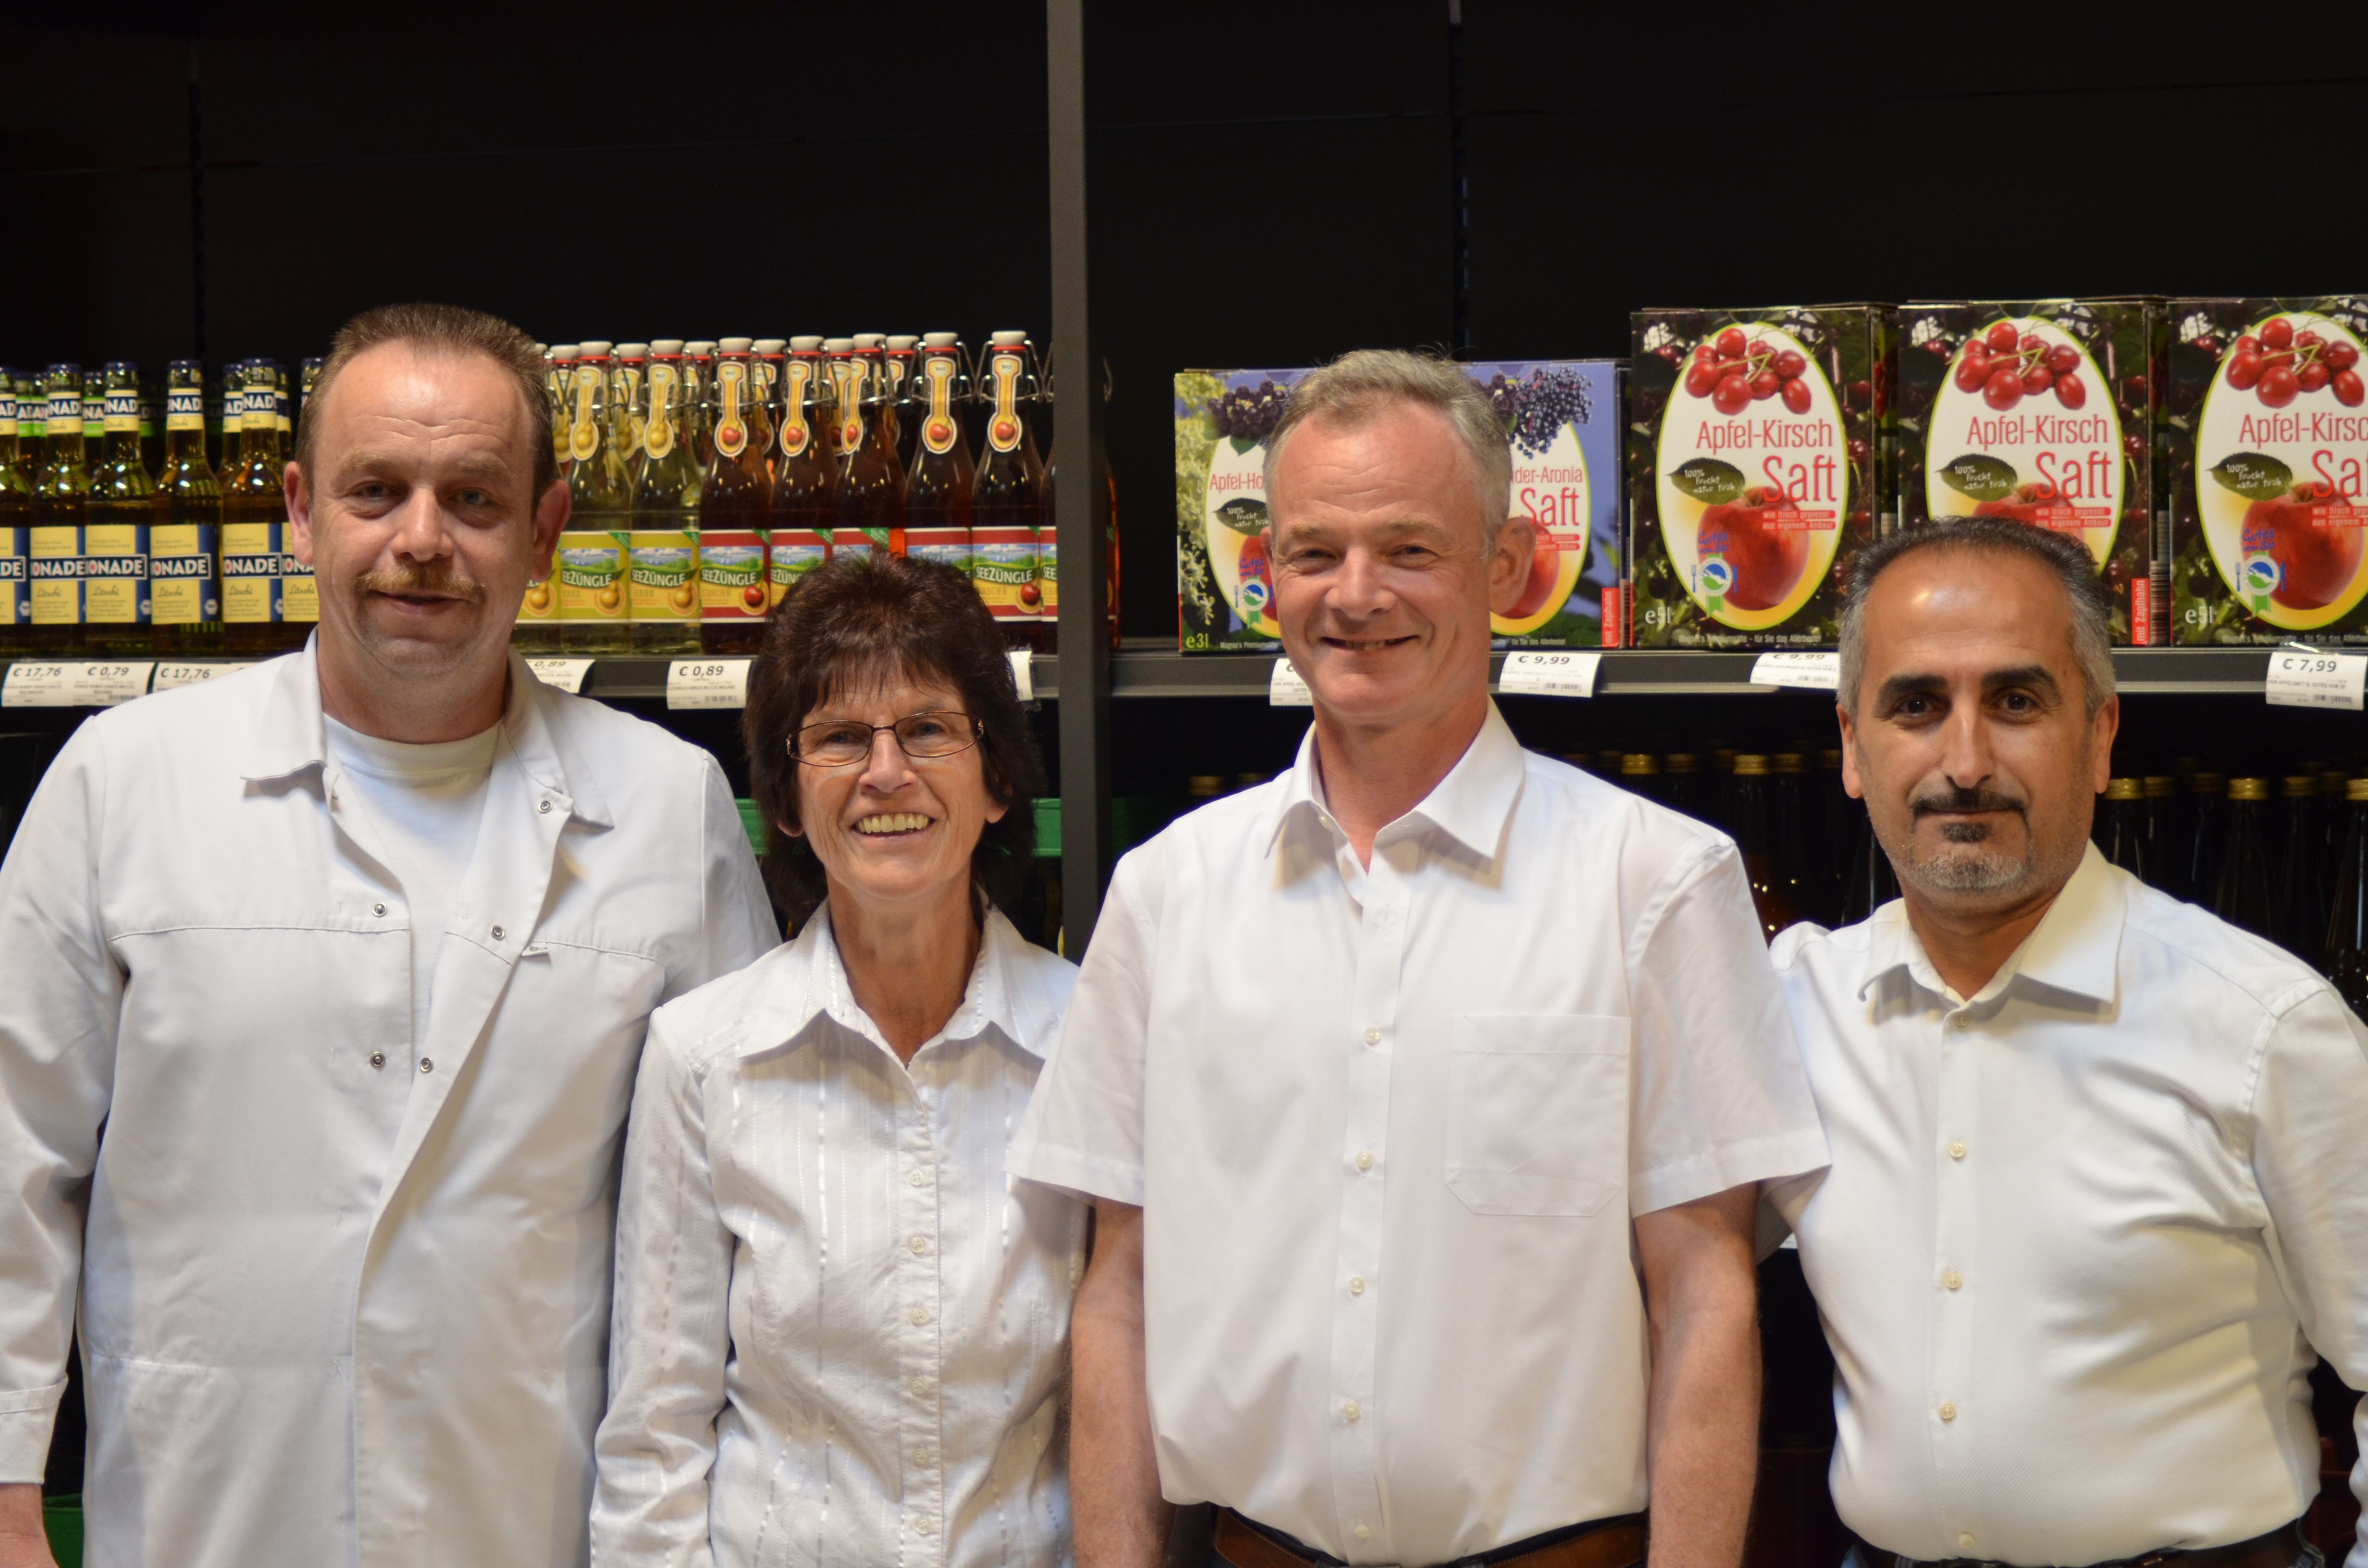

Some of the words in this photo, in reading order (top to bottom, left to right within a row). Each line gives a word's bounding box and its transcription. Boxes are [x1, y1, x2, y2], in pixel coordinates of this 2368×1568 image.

[1695, 418, 1833, 455] Apfel-Kirsch
[1966, 414, 2108, 452] Apfel-Kirsch
[2238, 412, 2368, 449] Apfel-Kirsc
[1512, 466, 1583, 484] der-Aronia
[1684, 469, 1705, 478] 100%
[1954, 465, 1975, 475] 100%
[2035, 451, 2112, 500] Saft
[2226, 464, 2248, 473] 100%
[2312, 449, 2368, 498] Sa
[1209, 472, 1264, 494] Apfel-Ho
[1762, 454, 1837, 502] Saft
[1693, 485, 1713, 494] natur
[1963, 482, 1985, 490] natur
[1227, 507, 1244, 515] 100%
[1519, 487, 1580, 527] Saft
[1698, 531, 1728, 545] Gutes
[2242, 527, 2275, 542] Gutes
[1239, 557, 1265, 569] Gutes
[702, 569, 757, 586] SEEZÜNGLE
[976, 566, 1033, 584] SEEZÜNGLE
[2135, 579, 2147, 623] Zapfhahn
[1603, 591, 1614, 628] Zapfhahn
[1603, 631, 1612, 644] mit
[1764, 634, 1774, 643] Sie
[1776, 634, 1788, 643] das
[2135, 626, 2145, 641] mit
[1534, 656, 1570, 665] 9,99
[2283, 659, 2293, 670] €
[2299, 659, 2337, 673] 7,99
[26, 667, 62, 678] 17,76
[99, 667, 129, 678] 0,79
[173, 669, 210, 679] 17,76
[692, 666, 724, 677] 0,89
